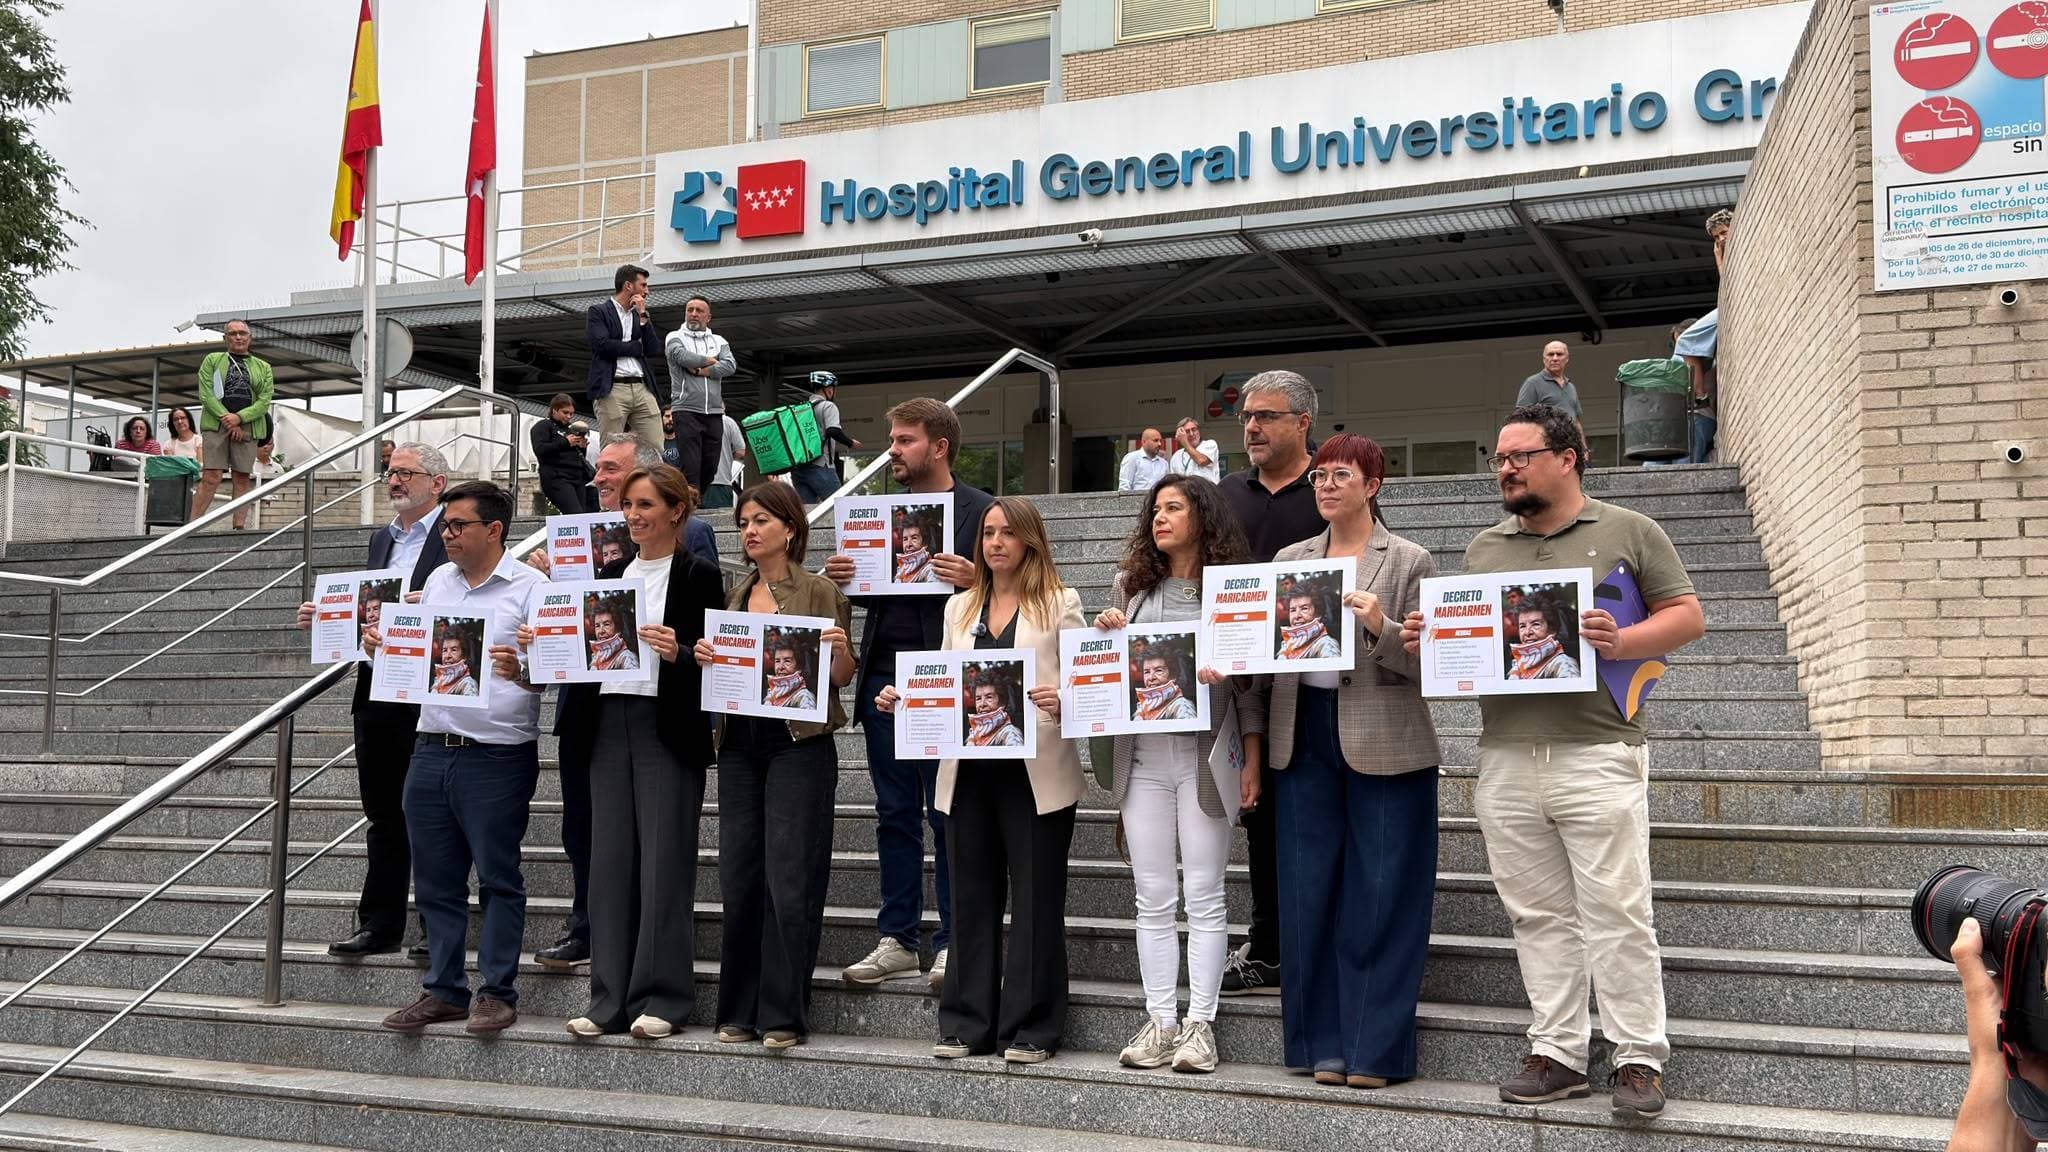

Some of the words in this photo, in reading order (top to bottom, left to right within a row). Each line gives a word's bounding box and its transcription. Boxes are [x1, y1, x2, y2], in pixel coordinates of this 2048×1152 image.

[1984, 120, 2042, 138] espacio
[2013, 136, 2042, 153] sin
[820, 159, 1025, 225] Hospital
[1040, 131, 1251, 200] General
[1270, 83, 1667, 174] Universitario
[1893, 190, 1956, 205] Prohibido
[1961, 186, 2000, 198] fumar
[2005, 186, 2012, 195] y
[2018, 182, 2029, 193] el
[1894, 203, 1958, 219] cigarrillos
[1930, 218, 1941, 228] el
[1946, 214, 1992, 227] recinto
[1944, 243, 1956, 251] de
[1971, 241, 1983, 249] de
[1985, 236, 2035, 248] diciembre,
[1888, 260, 1903, 268] por
[1905, 258, 1914, 266] la
[1976, 252, 1987, 260] de
[1989, 251, 2001, 259] 30
[2003, 250, 2015, 258] de
[1899, 269, 1915, 279] Ley
[1953, 264, 1965, 273] de
[1967, 263, 1978, 271] 27
[1980, 262, 1992, 271] de
[1995, 261, 2028, 270] marzo.
[849, 508, 878, 519] DECRETO
[557, 526, 579, 536] DECRETO
[843, 520, 885, 531] MARICARMEN
[554, 538, 585, 548] MARICARMEN
[327, 583, 350, 594] DECRETO
[1224, 577, 1260, 590] DECRETO
[320, 594, 353, 604] MARICARMEN
[544, 594, 571, 605] DECRETO
[1215, 591, 1268, 603] MARICARMEN
[1443, 589, 1483, 603] DECRETO
[537, 607, 577, 618] MARICARMEN
[1434, 604, 1492, 618] MARICARMEN
[394, 615, 421, 627] DECRETO
[387, 627, 427, 639] MARICARMEN
[719, 623, 749, 636] DECRETO
[712, 635, 756, 649] MARICARMEN
[1080, 639, 1113, 652] DECRETO
[1072, 652, 1121, 666] MARICARMEN
[914, 664, 947, 676] DECRETO
[907, 677, 955, 689] MARICARMEN
